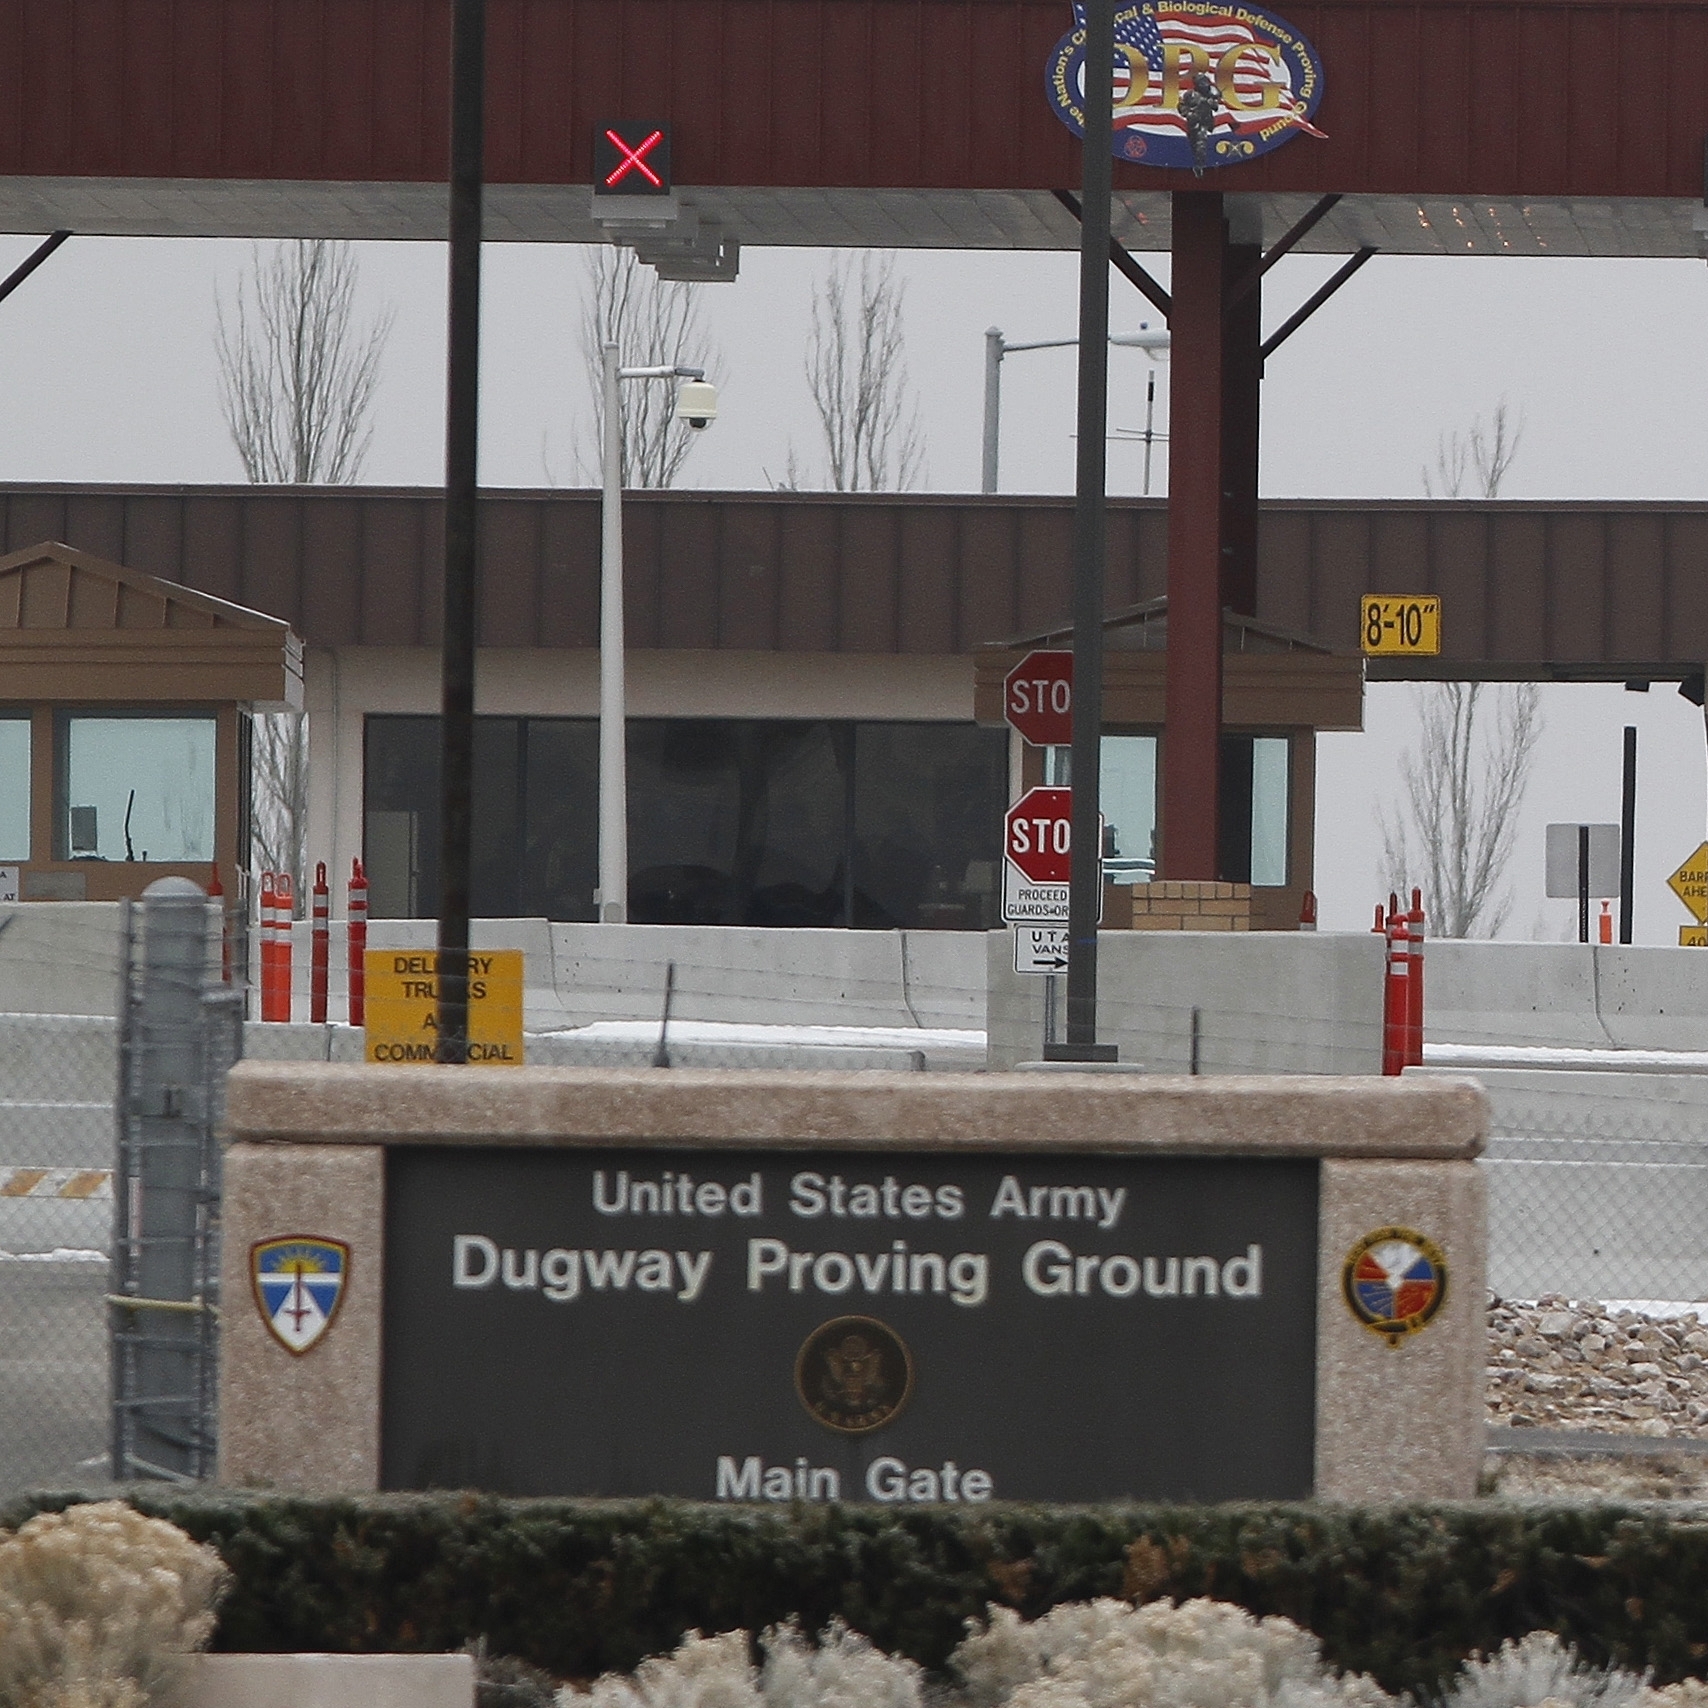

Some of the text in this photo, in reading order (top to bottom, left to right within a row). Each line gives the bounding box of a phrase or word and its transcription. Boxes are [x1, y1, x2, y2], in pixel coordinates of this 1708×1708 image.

[1142, 3, 1156, 15] &
[1157, 1, 1233, 17] Biological
[1236, 7, 1293, 44] Defense
[1052, 45, 1074, 108] Nation's
[1291, 41, 1316, 98] Proving
[1259, 100, 1308, 142] Gound
[1010, 680, 1071, 714] STO
[1011, 818, 1072, 854] STO
[1018, 889, 1067, 901] PROCEED
[394, 957, 493, 974] DELRY
[402, 981, 487, 999] TRUS
[374, 1043, 514, 1061] COMMCIAL
[592, 1170, 1128, 1229] United States Army
[452, 1233, 1263, 1307] Dugway Proving Ground
[716, 1455, 994, 1501] Main Gate
